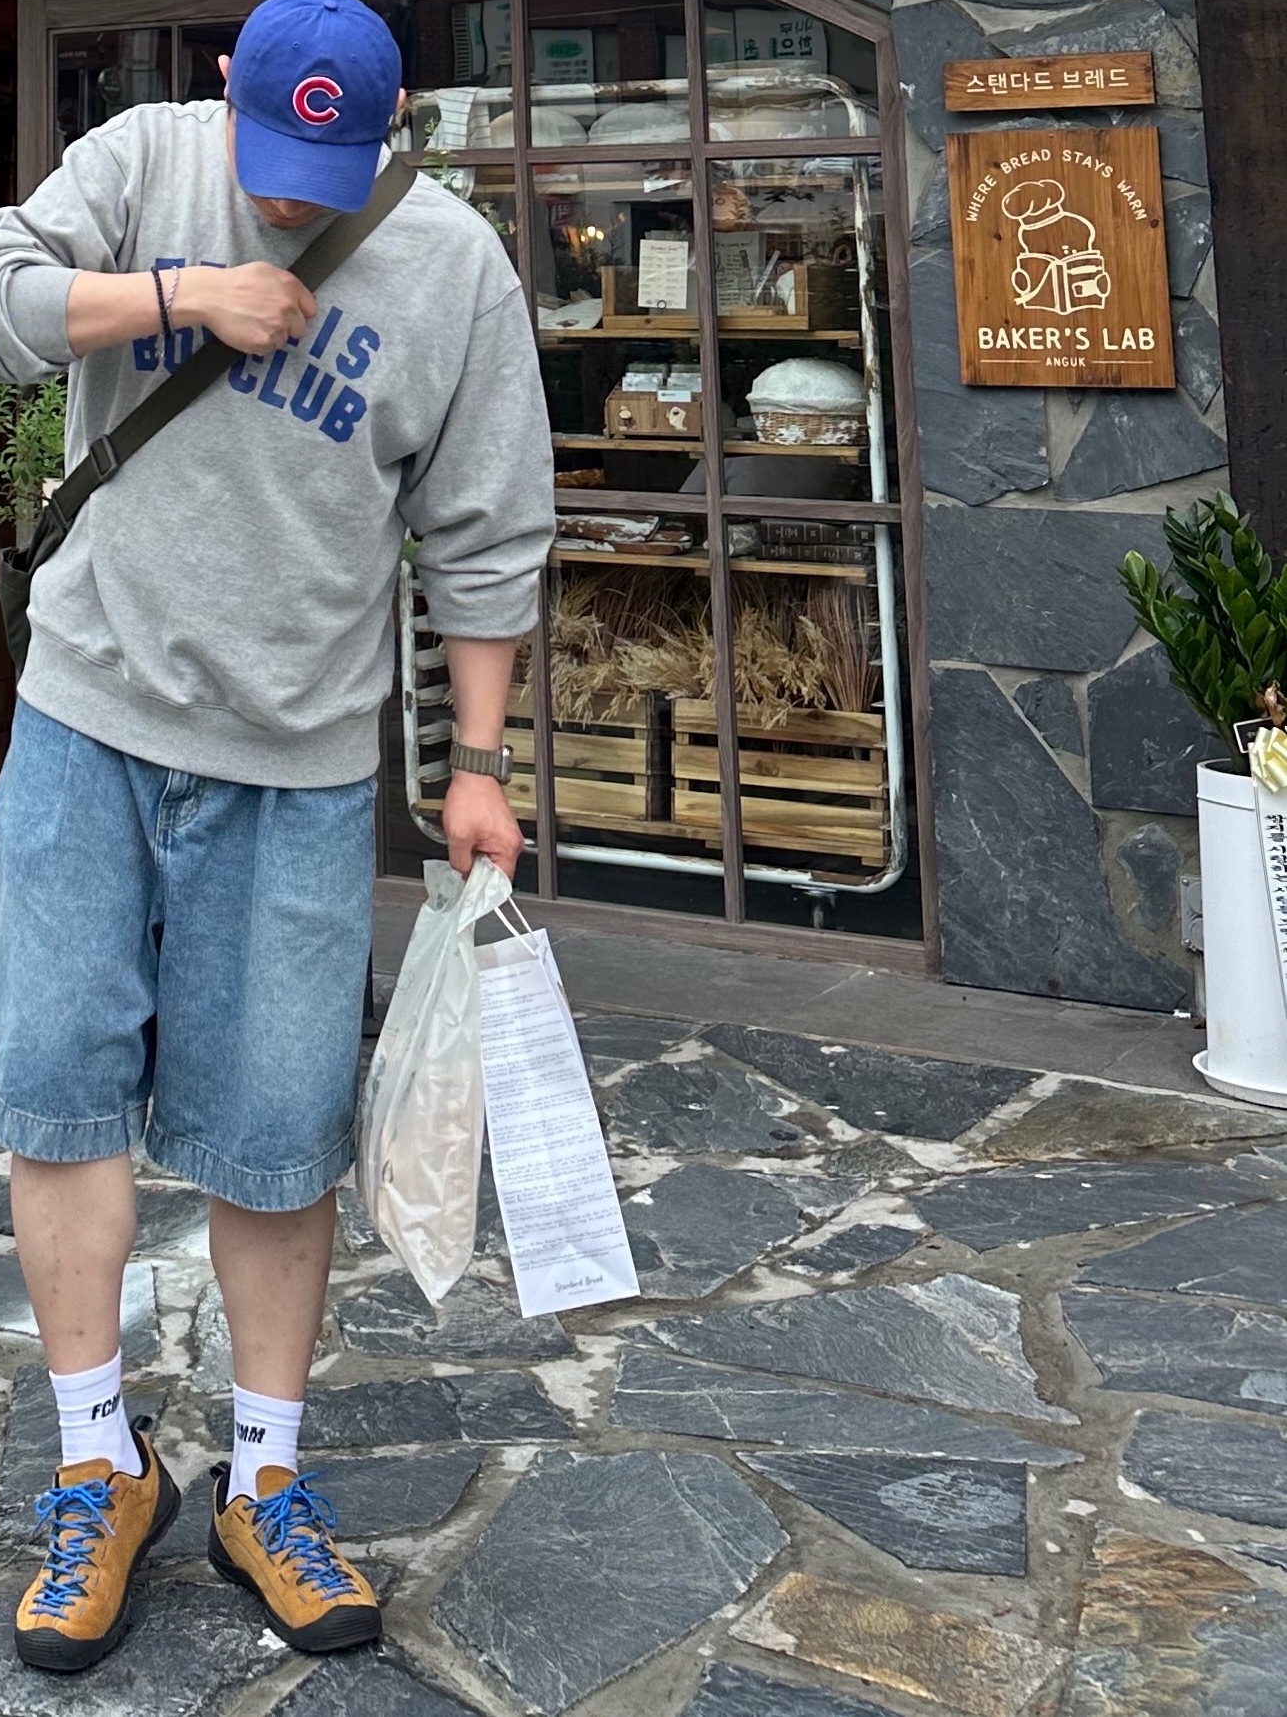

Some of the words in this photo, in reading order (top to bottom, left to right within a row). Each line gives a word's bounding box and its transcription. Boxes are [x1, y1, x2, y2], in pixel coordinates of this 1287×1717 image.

[292, 76, 343, 125] C
[966, 72, 1054, 95] 스탠다드
[1062, 69, 1130, 90] 브레드
[966, 174, 998, 223] WHERE
[1000, 148, 1052, 175] BREAD
[1061, 149, 1114, 179] STAYS
[1116, 179, 1148, 222] WARM
[977, 327, 1091, 351] BAKER'S
[1102, 328, 1156, 351] LAB
[1045, 356, 1087, 368] ANGUK
[228, 349, 368, 443] CLUB
